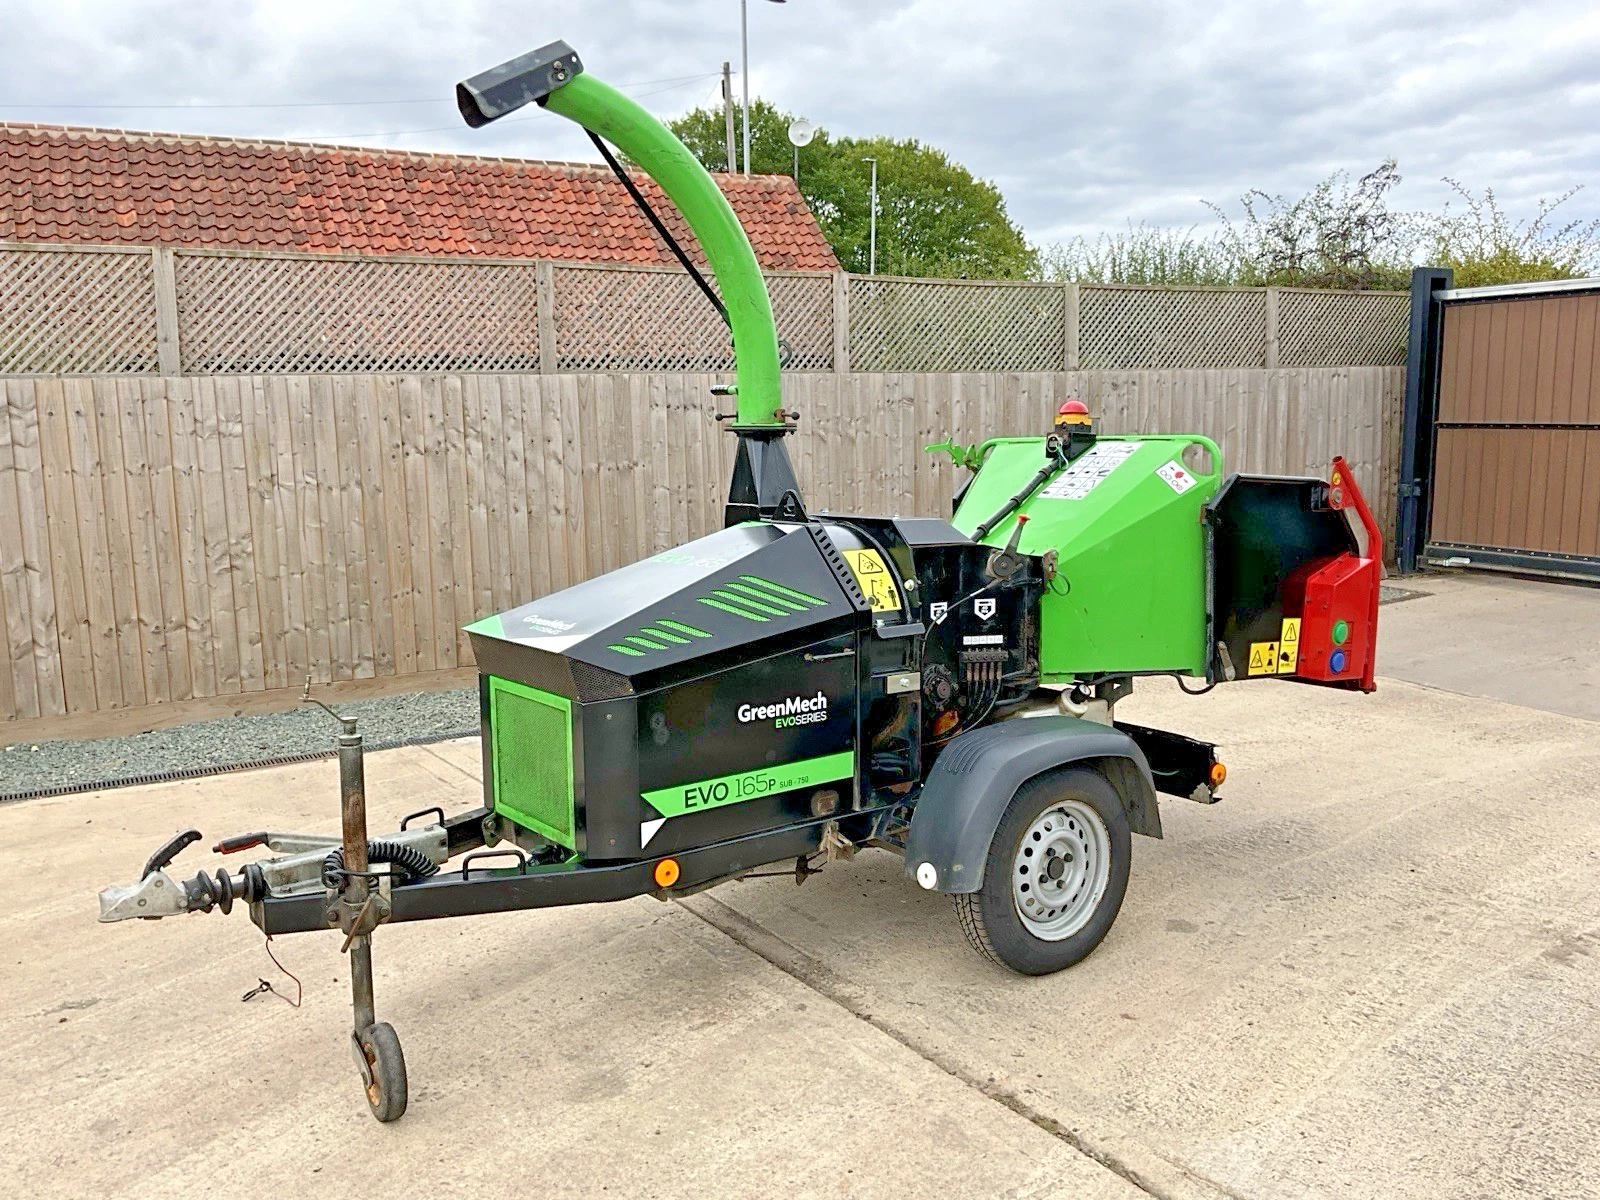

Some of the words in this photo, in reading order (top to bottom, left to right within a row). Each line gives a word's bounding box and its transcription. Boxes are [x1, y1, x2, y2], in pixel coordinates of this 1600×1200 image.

[738, 691, 827, 722] GreenMech
[775, 711, 827, 728] EVOSERIES
[684, 782, 729, 808] EVO
[780, 780, 793, 789] SUB
[798, 775, 809, 784] 750
